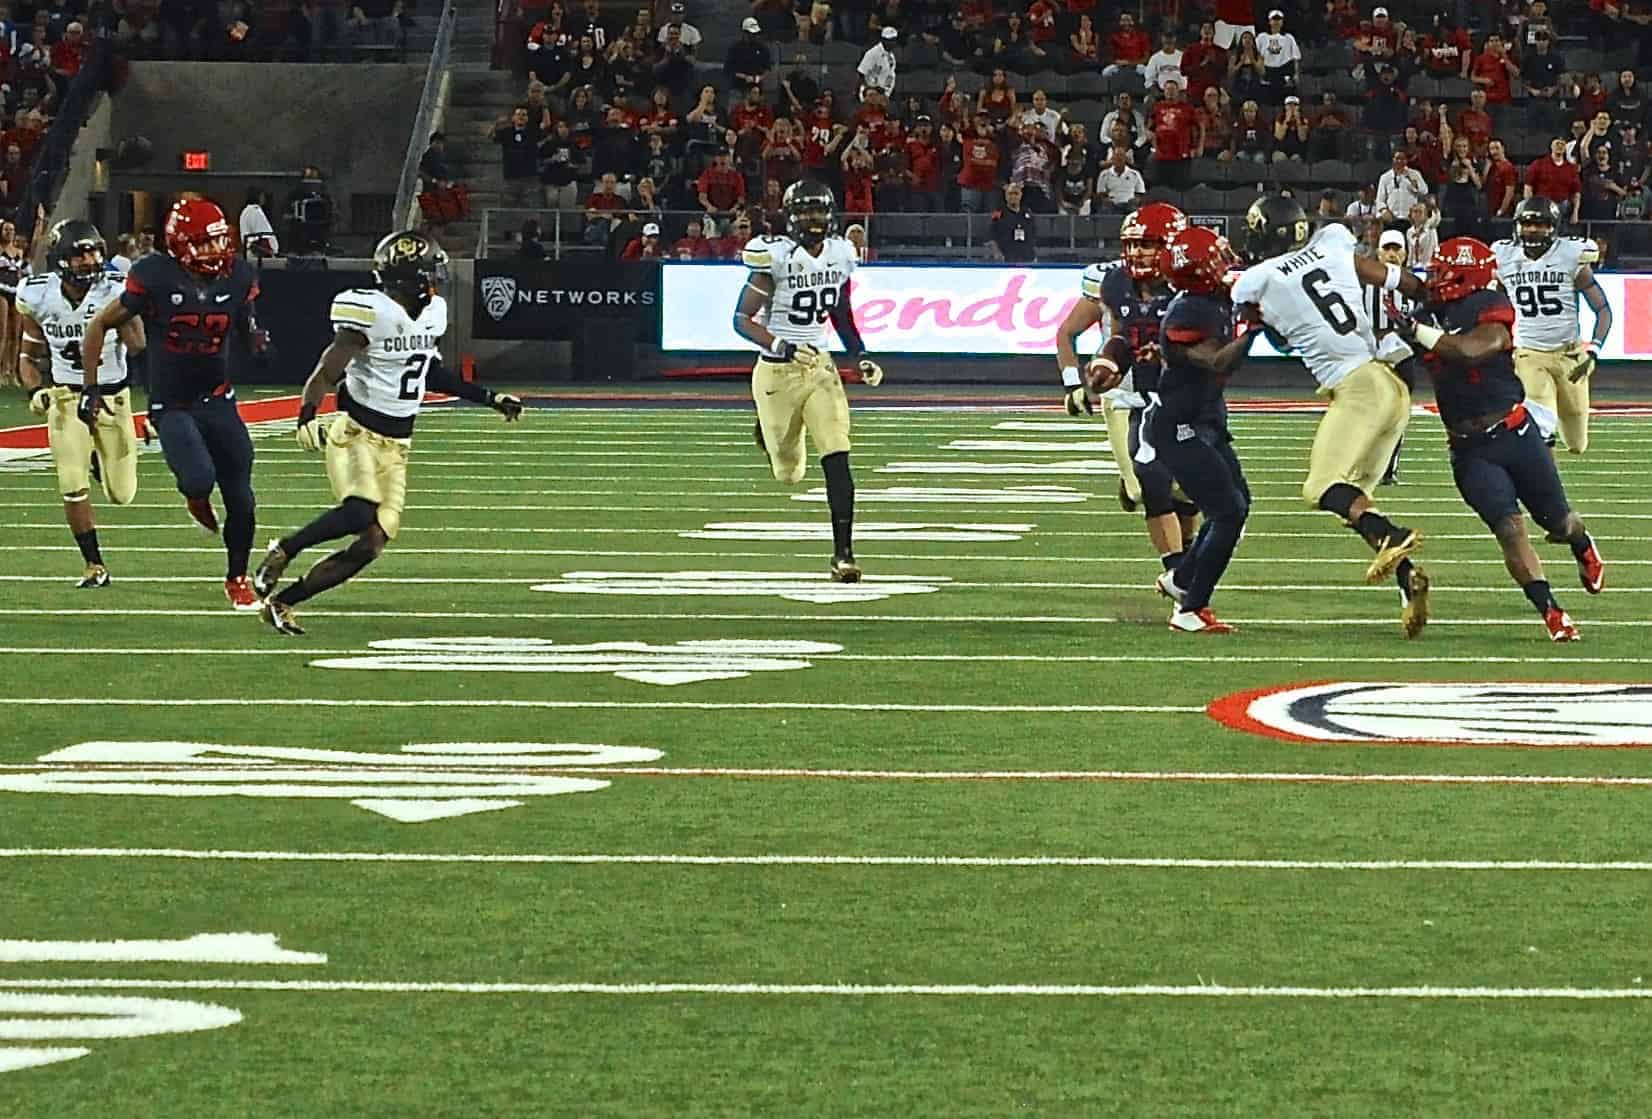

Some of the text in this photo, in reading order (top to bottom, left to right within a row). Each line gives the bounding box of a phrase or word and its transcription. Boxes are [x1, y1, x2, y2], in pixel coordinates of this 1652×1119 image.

[1276, 246, 1325, 276] WHITE
[481, 277, 516, 299] PAC
[518, 289, 657, 305] NETWORKS
[1302, 268, 1357, 336] 6
[1515, 285, 1564, 318] 95
[489, 299, 507, 314] 12
[850, 274, 1082, 348] endy
[45, 323, 84, 338] COLOR
[398, 354, 427, 400] 2
